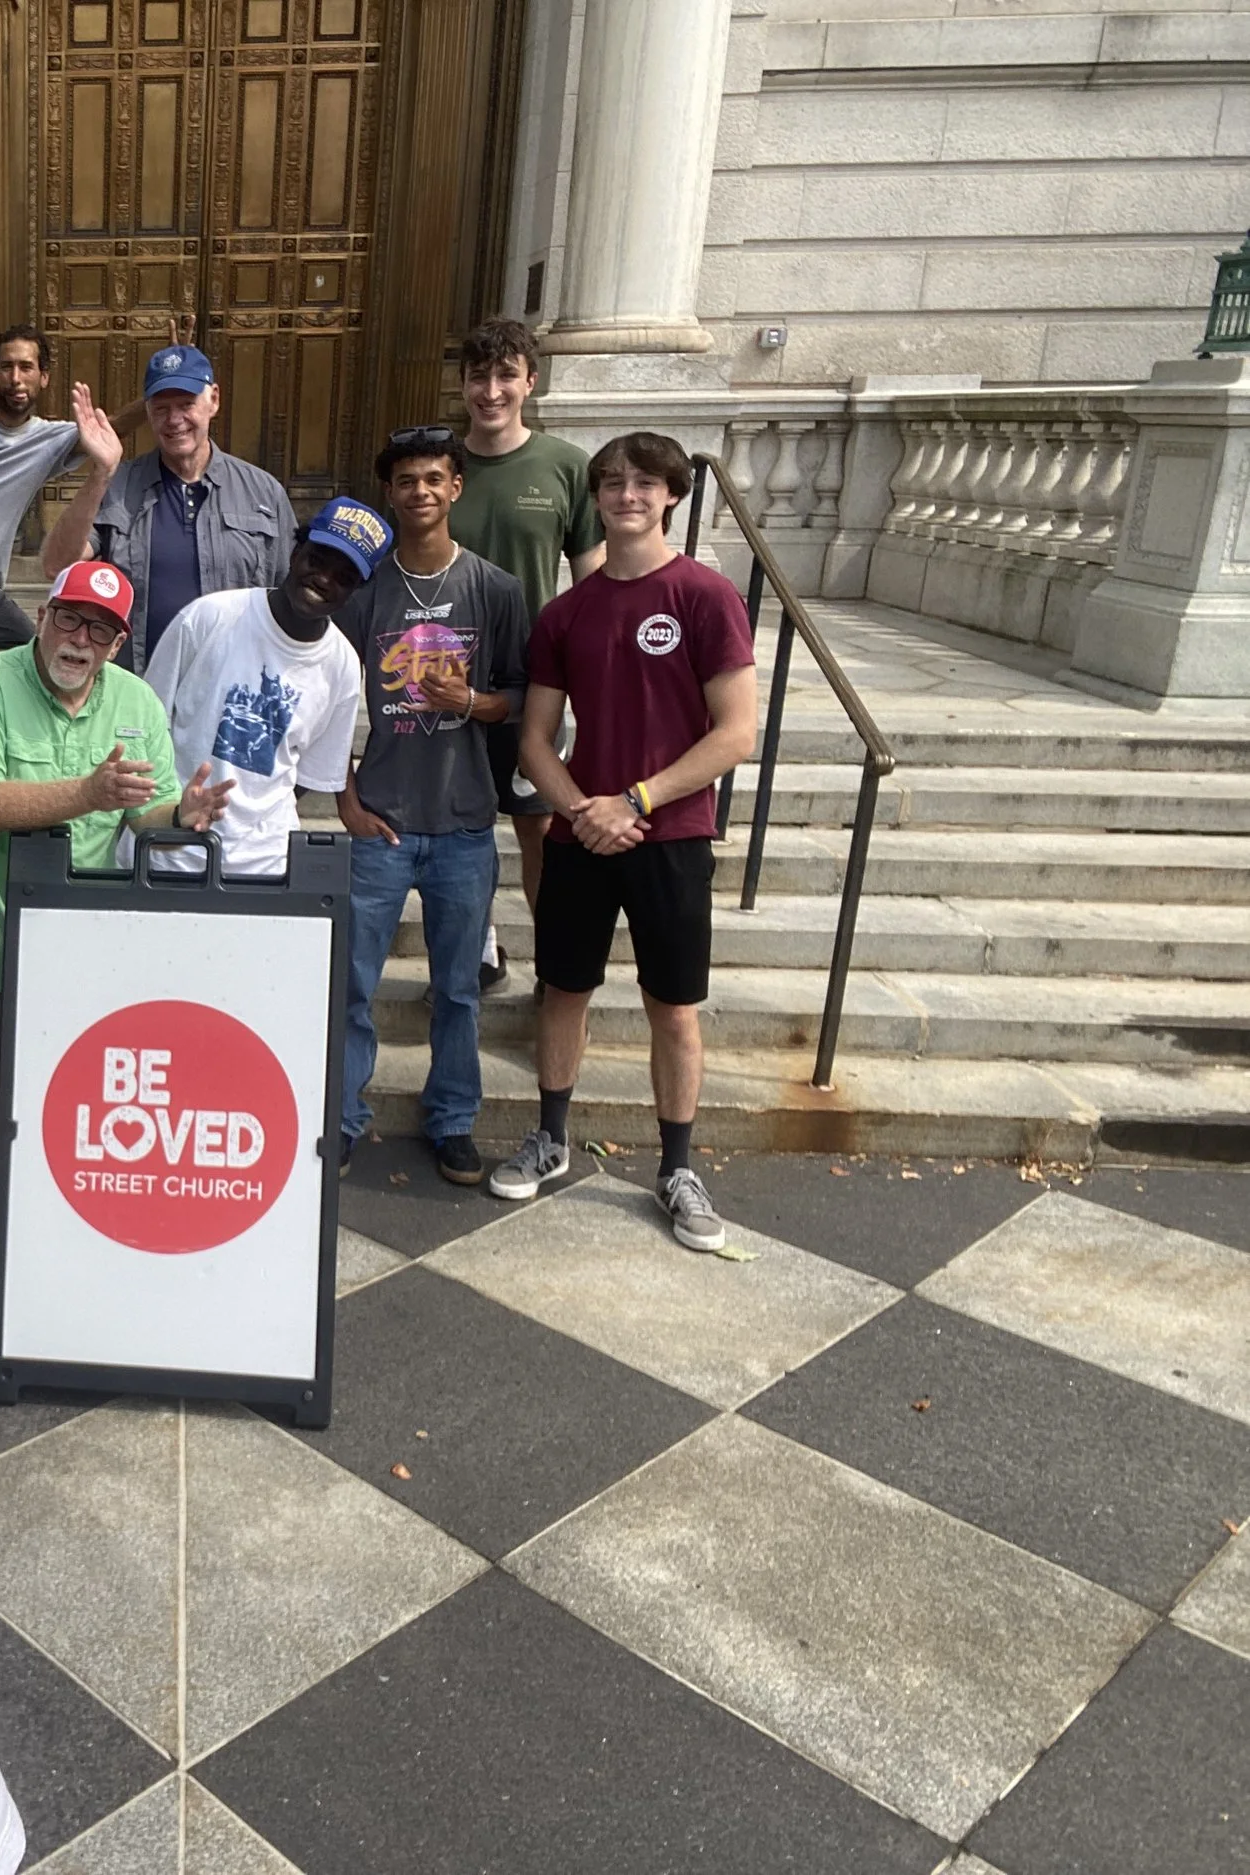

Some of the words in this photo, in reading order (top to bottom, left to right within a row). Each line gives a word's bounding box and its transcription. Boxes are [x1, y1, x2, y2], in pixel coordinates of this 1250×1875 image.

[333, 506, 387, 549] WARRIORS
[436, 633, 474, 644] England
[646, 627, 672, 641] 2023
[103, 1047, 171, 1105] BE
[75, 1104, 265, 1169] LOVED
[74, 1171, 158, 1195] STREET
[163, 1176, 263, 1201] CHURCH
